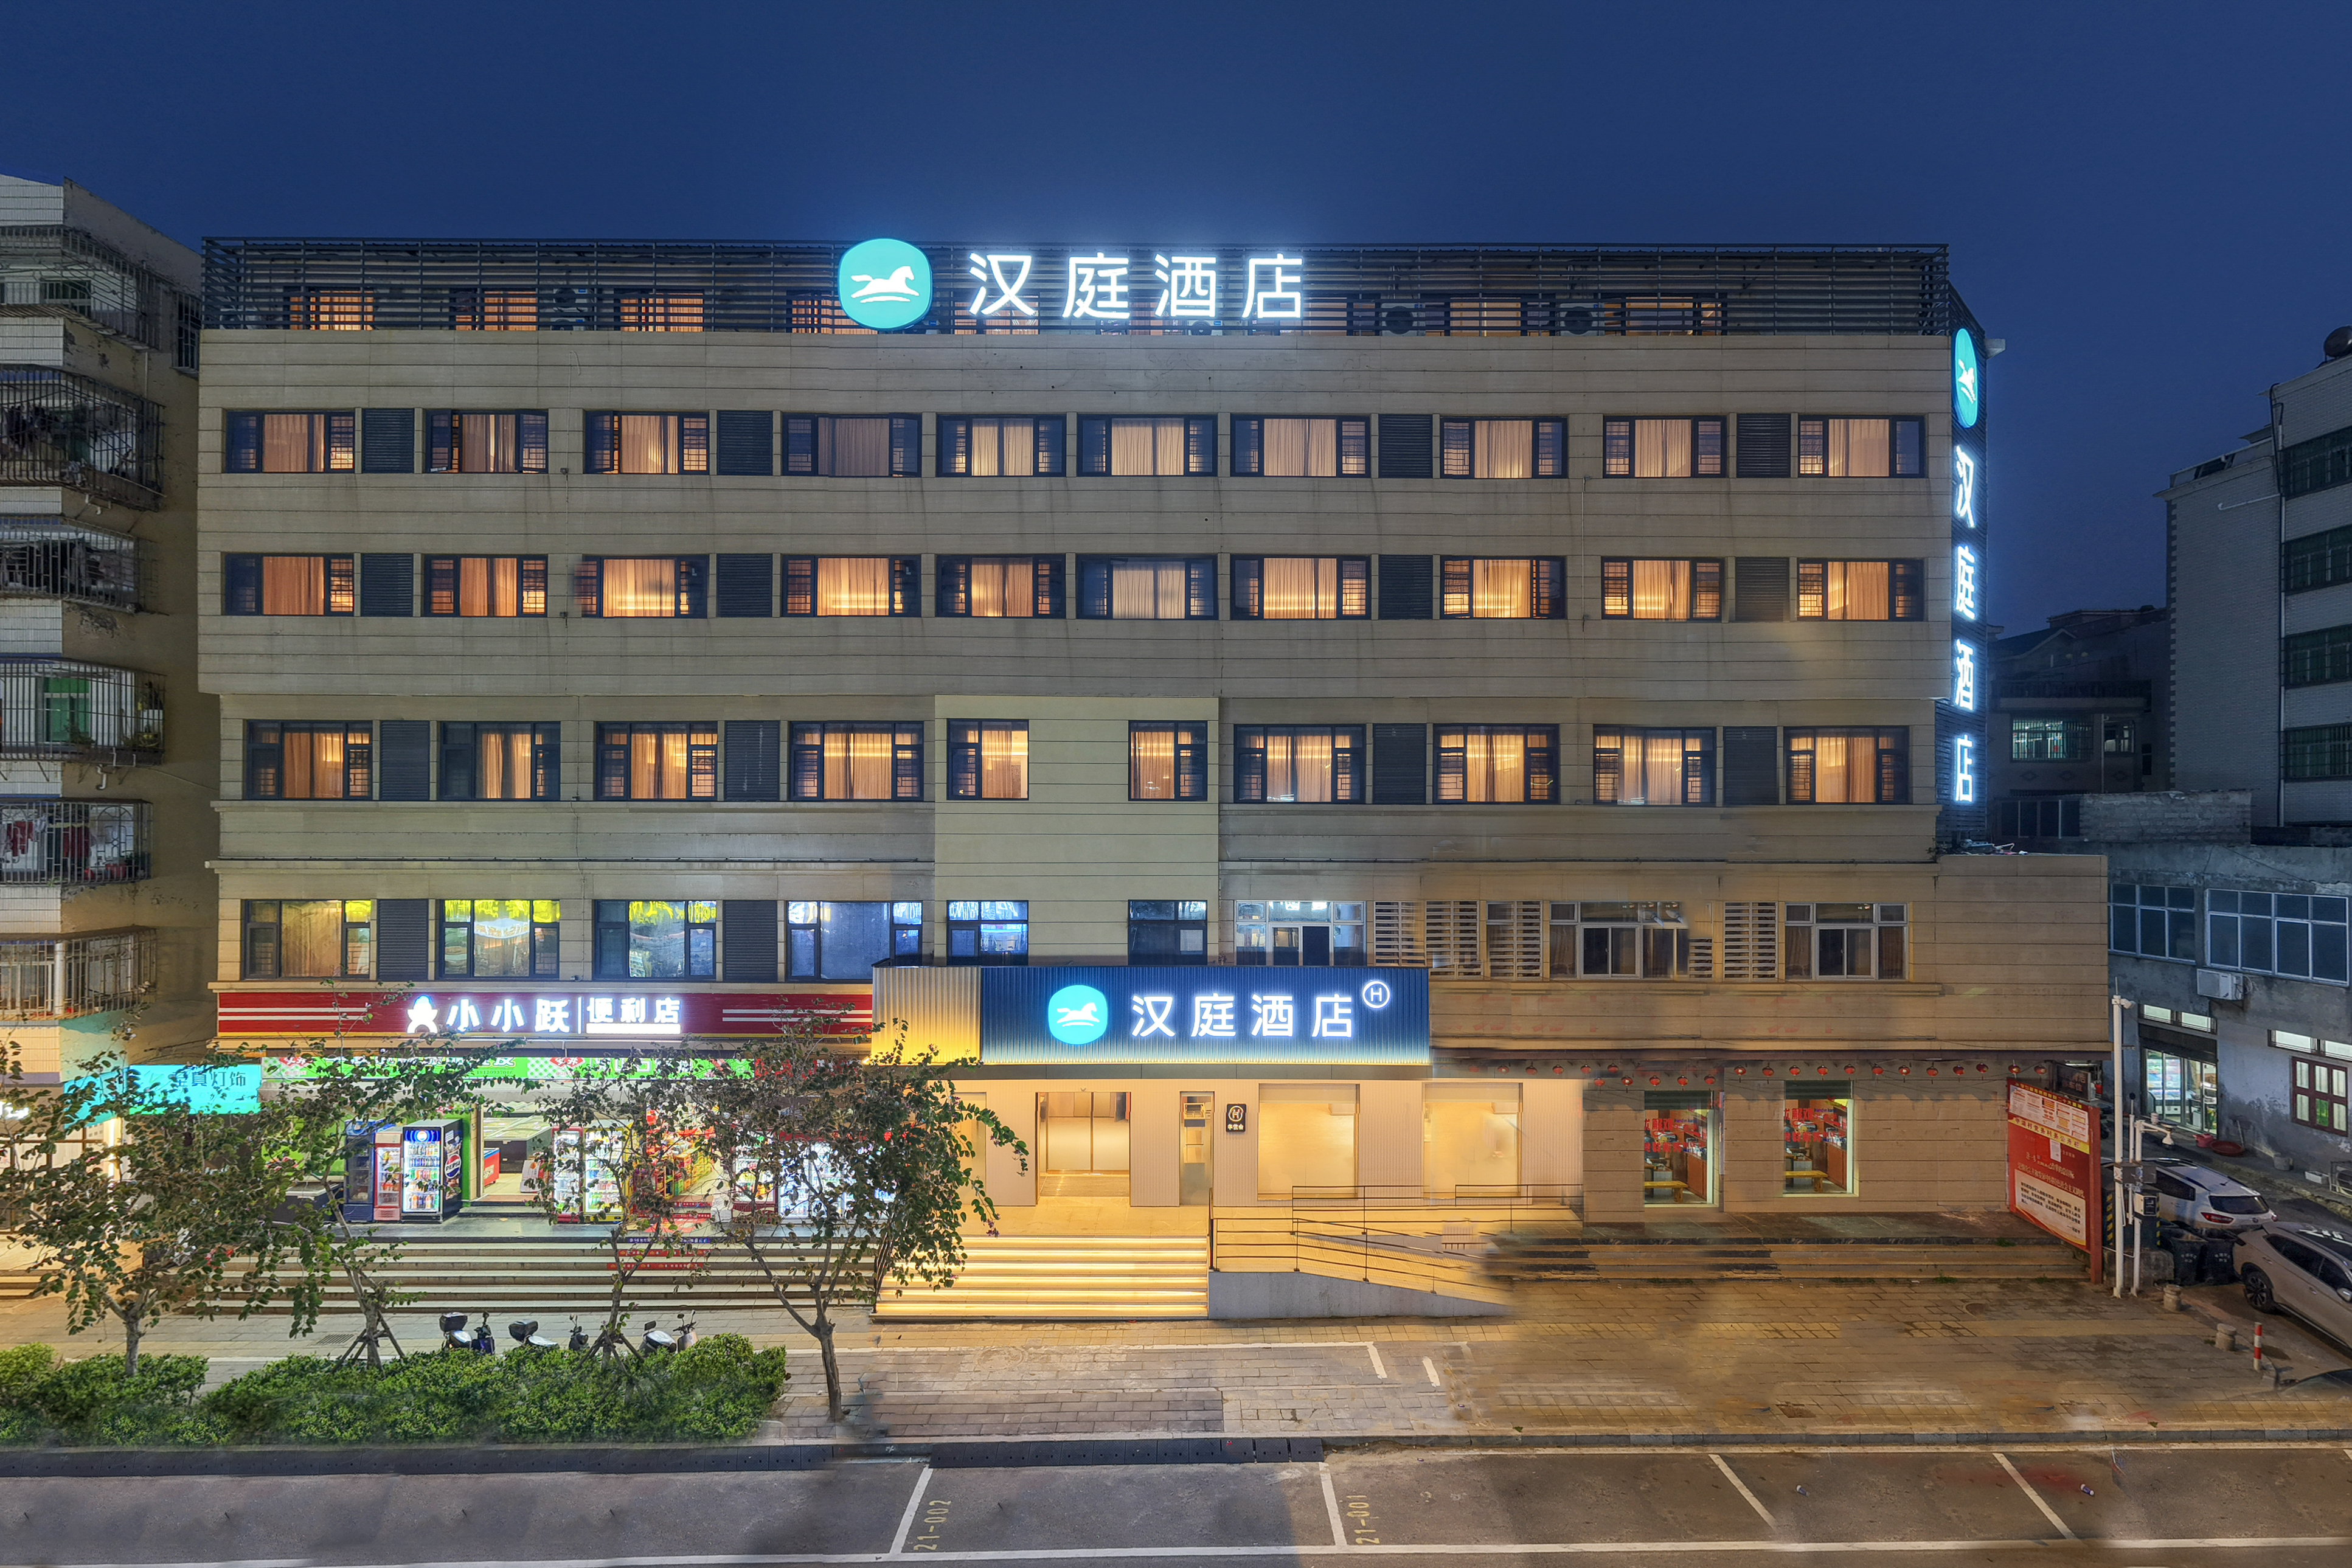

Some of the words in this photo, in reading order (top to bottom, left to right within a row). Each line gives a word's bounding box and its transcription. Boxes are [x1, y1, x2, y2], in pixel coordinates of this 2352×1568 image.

[969, 252, 1303, 319] 汉庭酒店
[1954, 445, 1976, 803] 汉庭酒店
[446, 999, 569, 1033] 小小跃
[586, 997, 681, 1024] 便利店
[1131, 993, 1353, 1038] 汉庭酒店
[446, 1160, 460, 1171] PEPSI
[914, 1500, 951, 1550] 21-002
[1346, 1495, 1380, 1544] 21-001
